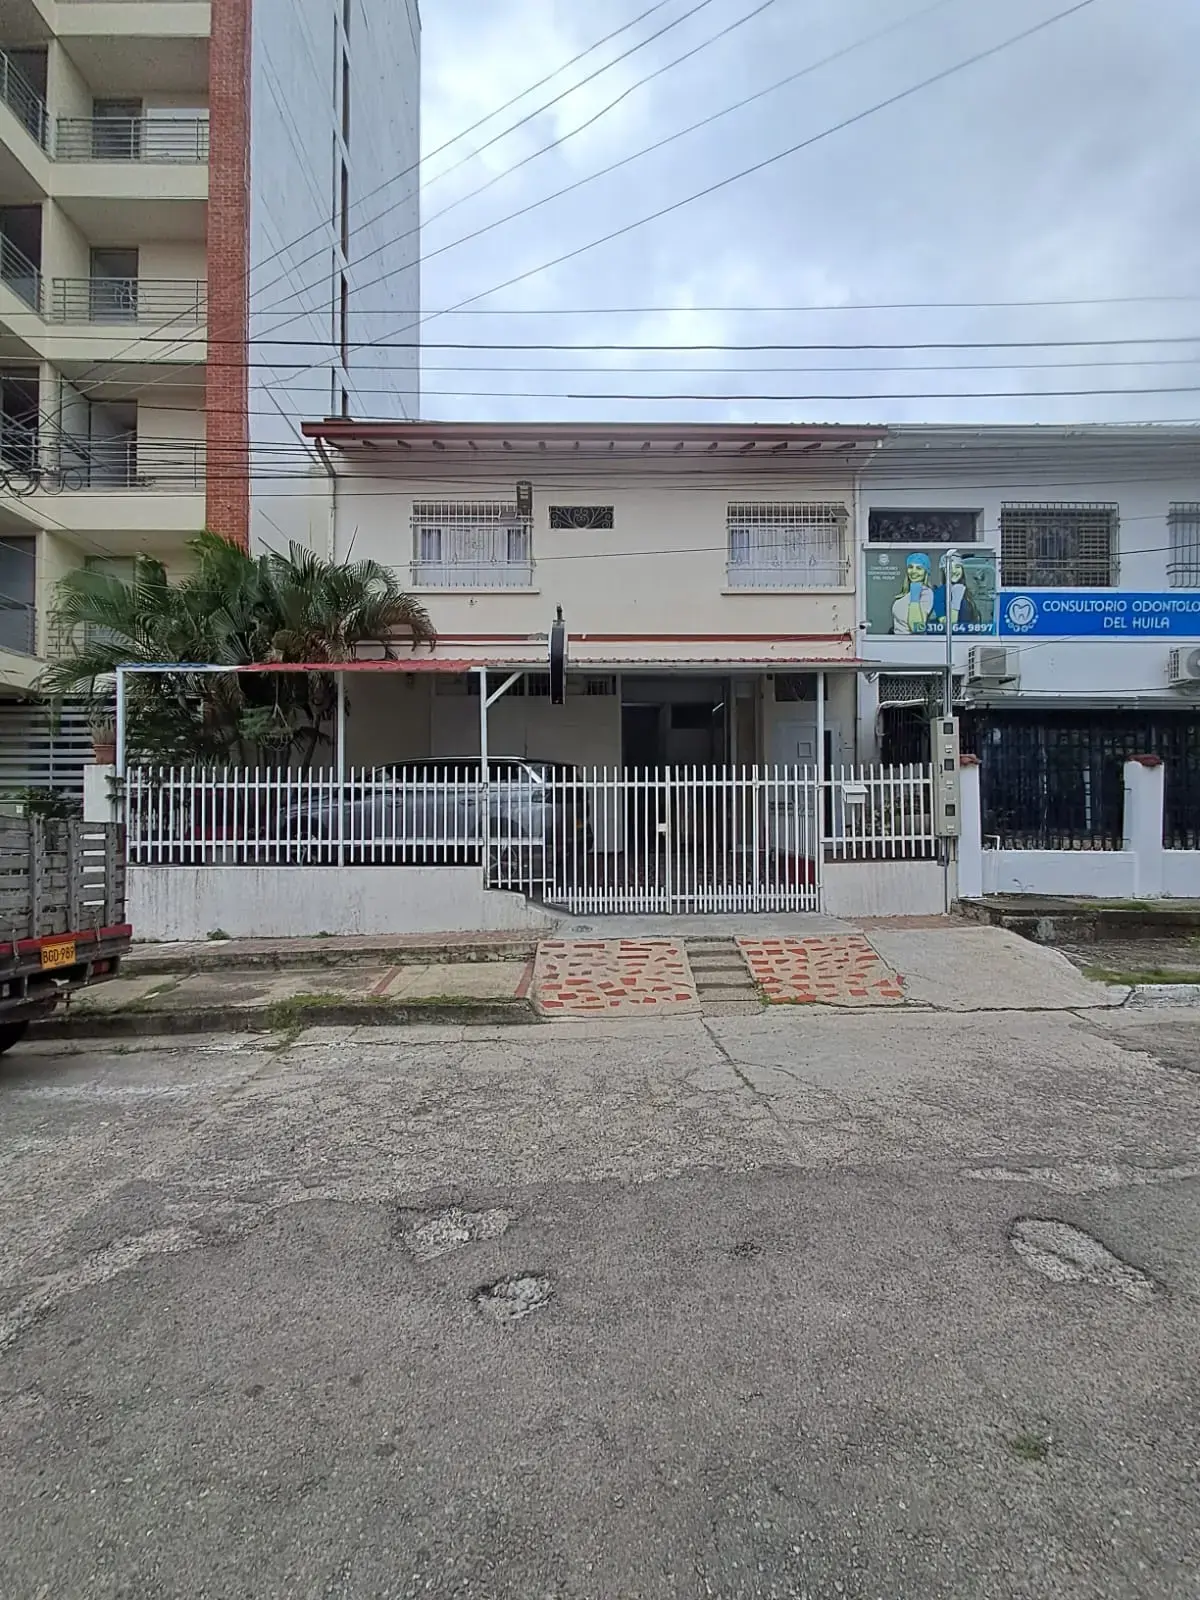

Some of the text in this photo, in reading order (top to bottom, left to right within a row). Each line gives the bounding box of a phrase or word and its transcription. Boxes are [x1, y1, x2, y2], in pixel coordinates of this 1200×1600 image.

[1042, 600, 1127, 612] CONSULTORIO
[927, 623, 993, 632] 310 64 9897
[1103, 616, 1170, 629] DEL HUILA
